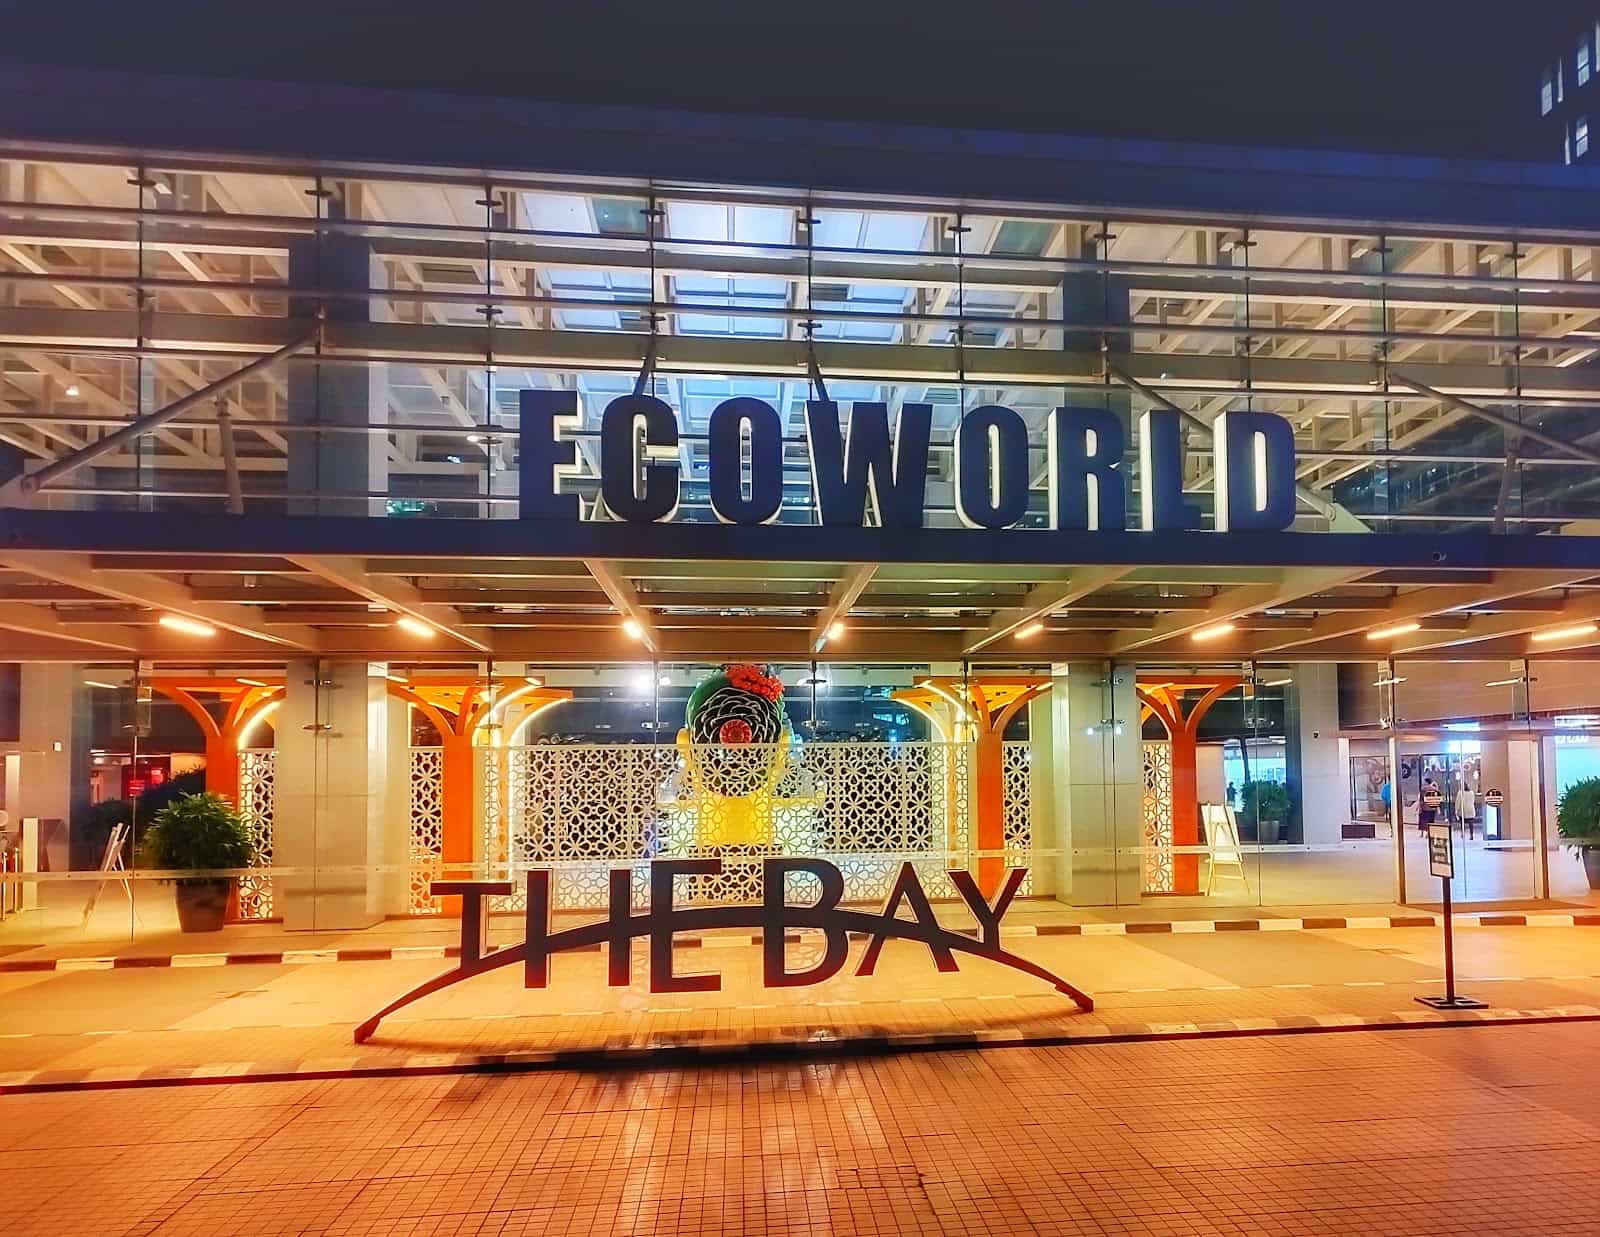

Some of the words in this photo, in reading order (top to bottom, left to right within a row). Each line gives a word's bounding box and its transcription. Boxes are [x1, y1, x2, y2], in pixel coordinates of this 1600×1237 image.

[520, 390, 1297, 533] ECOWORLD
[431, 859, 722, 993] THE
[763, 857, 1029, 988] BAY
